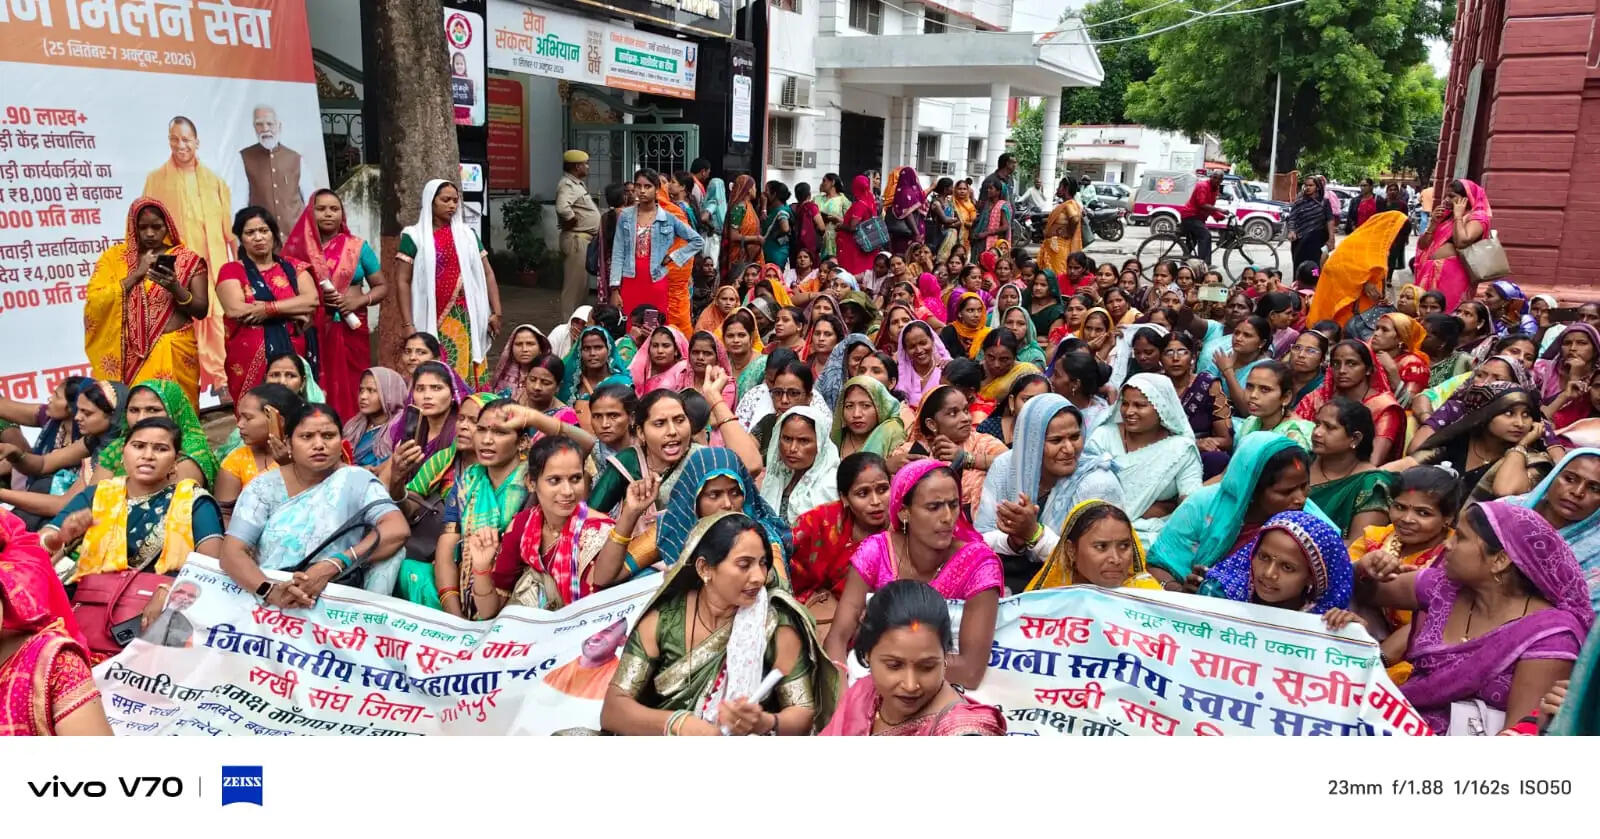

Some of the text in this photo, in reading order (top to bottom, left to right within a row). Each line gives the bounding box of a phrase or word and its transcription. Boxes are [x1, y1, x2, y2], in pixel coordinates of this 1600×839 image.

[198, 0, 273, 49] सेवा
[522, 8, 546, 34] सेवा
[495, 26, 534, 54] संकल्प
[536, 33, 581, 62] अभियान
[587, 44, 599, 60] 25
[33, 107, 88, 126] लाख+
[15, 129, 40, 150] केंद्र
[41, 130, 97, 149] संचालित
[94, 164, 112, 178] का
[8, 186, 62, 205] ₹8,000
[64, 182, 79, 202] से
[80, 186, 123, 205] बढ़ाकर
[36, 204, 67, 228] प्रति
[68, 208, 102, 226] माह
[23, 263, 75, 283] ₹4,000
[77, 259, 91, 278] से
[43, 281, 73, 306] प्रति
[251, 603, 308, 640] समूह
[311, 621, 370, 652] सखी
[374, 634, 413, 662] सात
[326, 607, 359, 625] समूह
[361, 610, 389, 627] सखी
[391, 616, 419, 634] दीदी
[1123, 606, 1166, 630] समूह
[1172, 618, 1214, 641] सखी
[1218, 626, 1258, 650] दीदी
[1264, 638, 1318, 662] एकता
[204, 622, 274, 660] जिला
[276, 641, 359, 685] स्तरीय
[1019, 614, 1095, 648] समूह
[1102, 620, 1182, 667] सखी
[1189, 648, 1263, 688] सात
[249, 665, 300, 701] सखी
[308, 684, 354, 713] संघ
[357, 692, 434, 724] जिला-
[987, 638, 1062, 678] जला
[1067, 651, 1173, 700] स्तरीय
[1178, 681, 1265, 730] स्वयं
[111, 693, 147, 715] समूह
[1033, 680, 1106, 712] सखी
[1118, 698, 1180, 736] संघ
[1006, 706, 1078, 735] समक्ष
